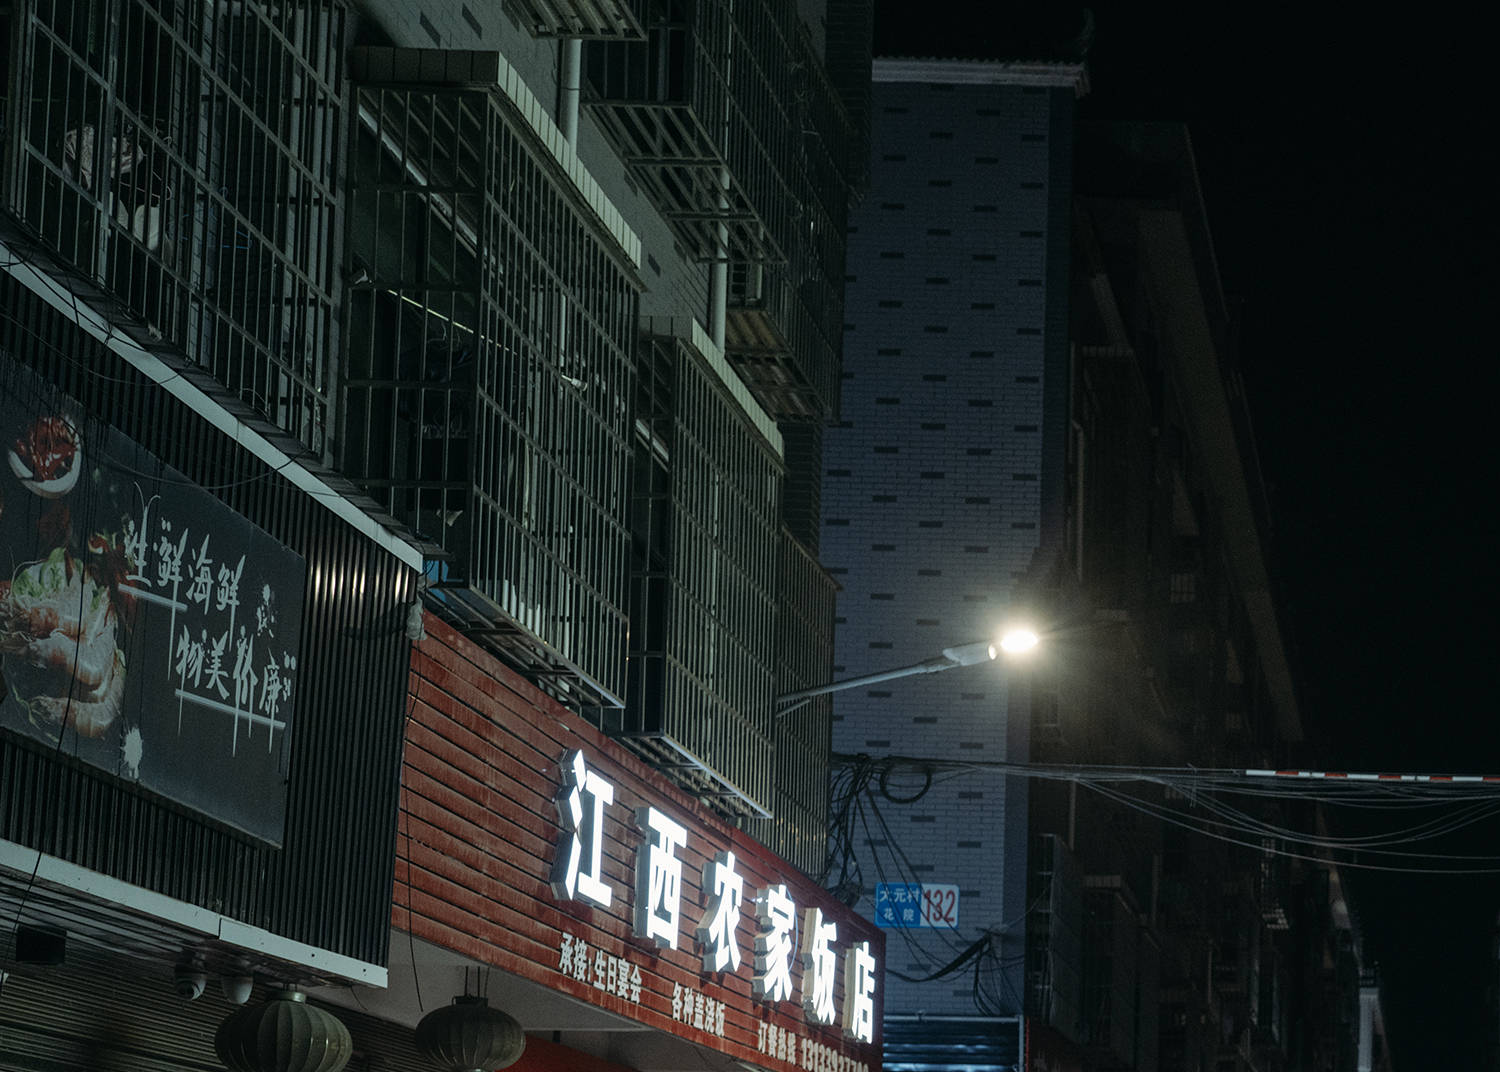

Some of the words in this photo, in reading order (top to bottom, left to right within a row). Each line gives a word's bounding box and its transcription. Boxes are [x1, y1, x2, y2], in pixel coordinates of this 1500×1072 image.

[555, 749, 877, 1046] 江西农家饭店
[922, 889, 956, 922] 132
[671, 981, 726, 1038] 各种盖浇饭
